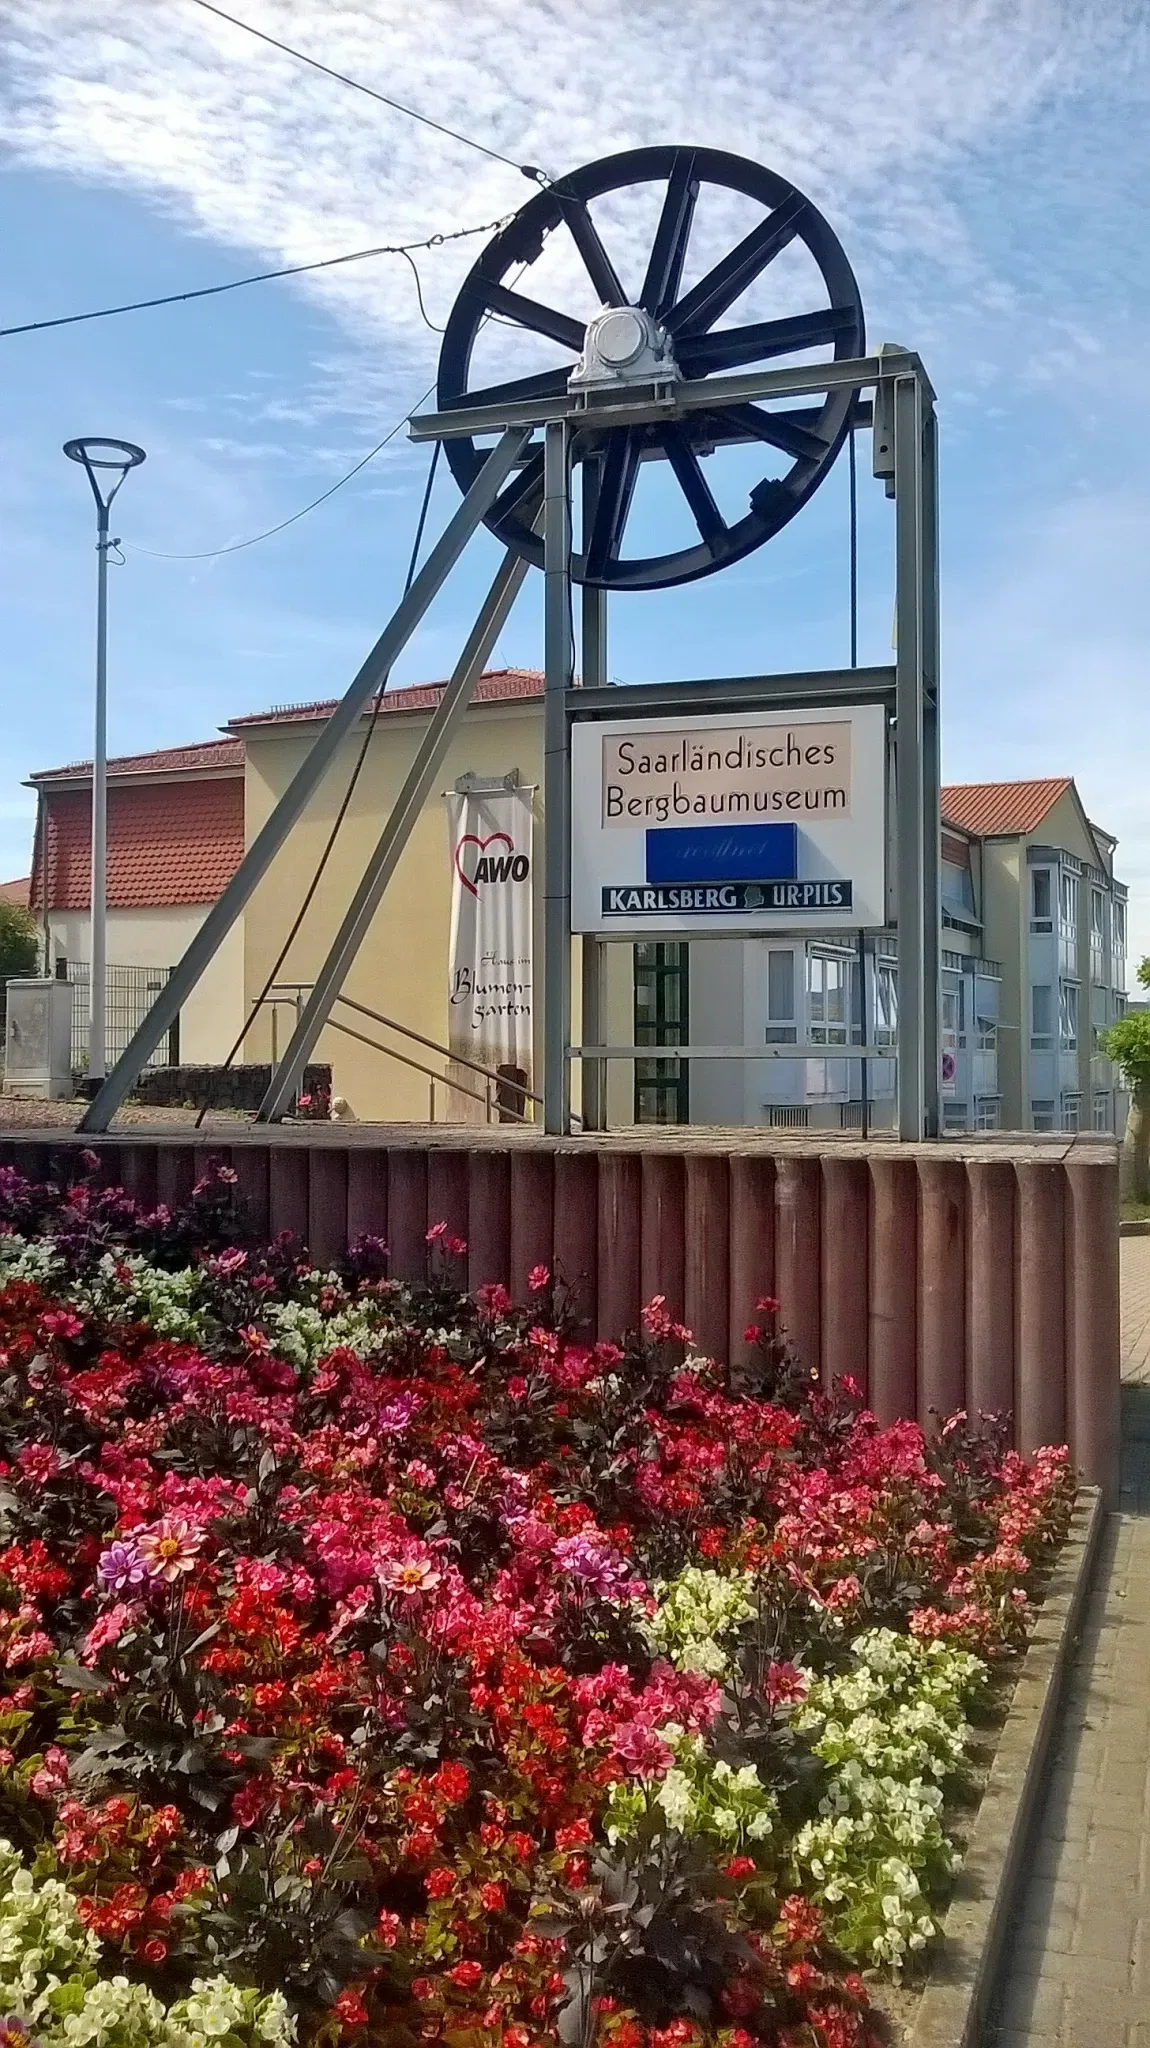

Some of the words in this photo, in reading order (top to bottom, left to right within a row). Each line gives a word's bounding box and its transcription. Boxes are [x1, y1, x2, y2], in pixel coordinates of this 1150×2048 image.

[618, 732, 834, 775] Saarländisches
[607, 781, 846, 821] Bergbaumuseum
[474, 855, 529, 884] AWO
[610, 886, 737, 910] KARLSBERG
[773, 883, 842, 905] UR-PILS
[450, 967, 532, 1004] Blumen-
[471, 1001, 530, 1029] garten
